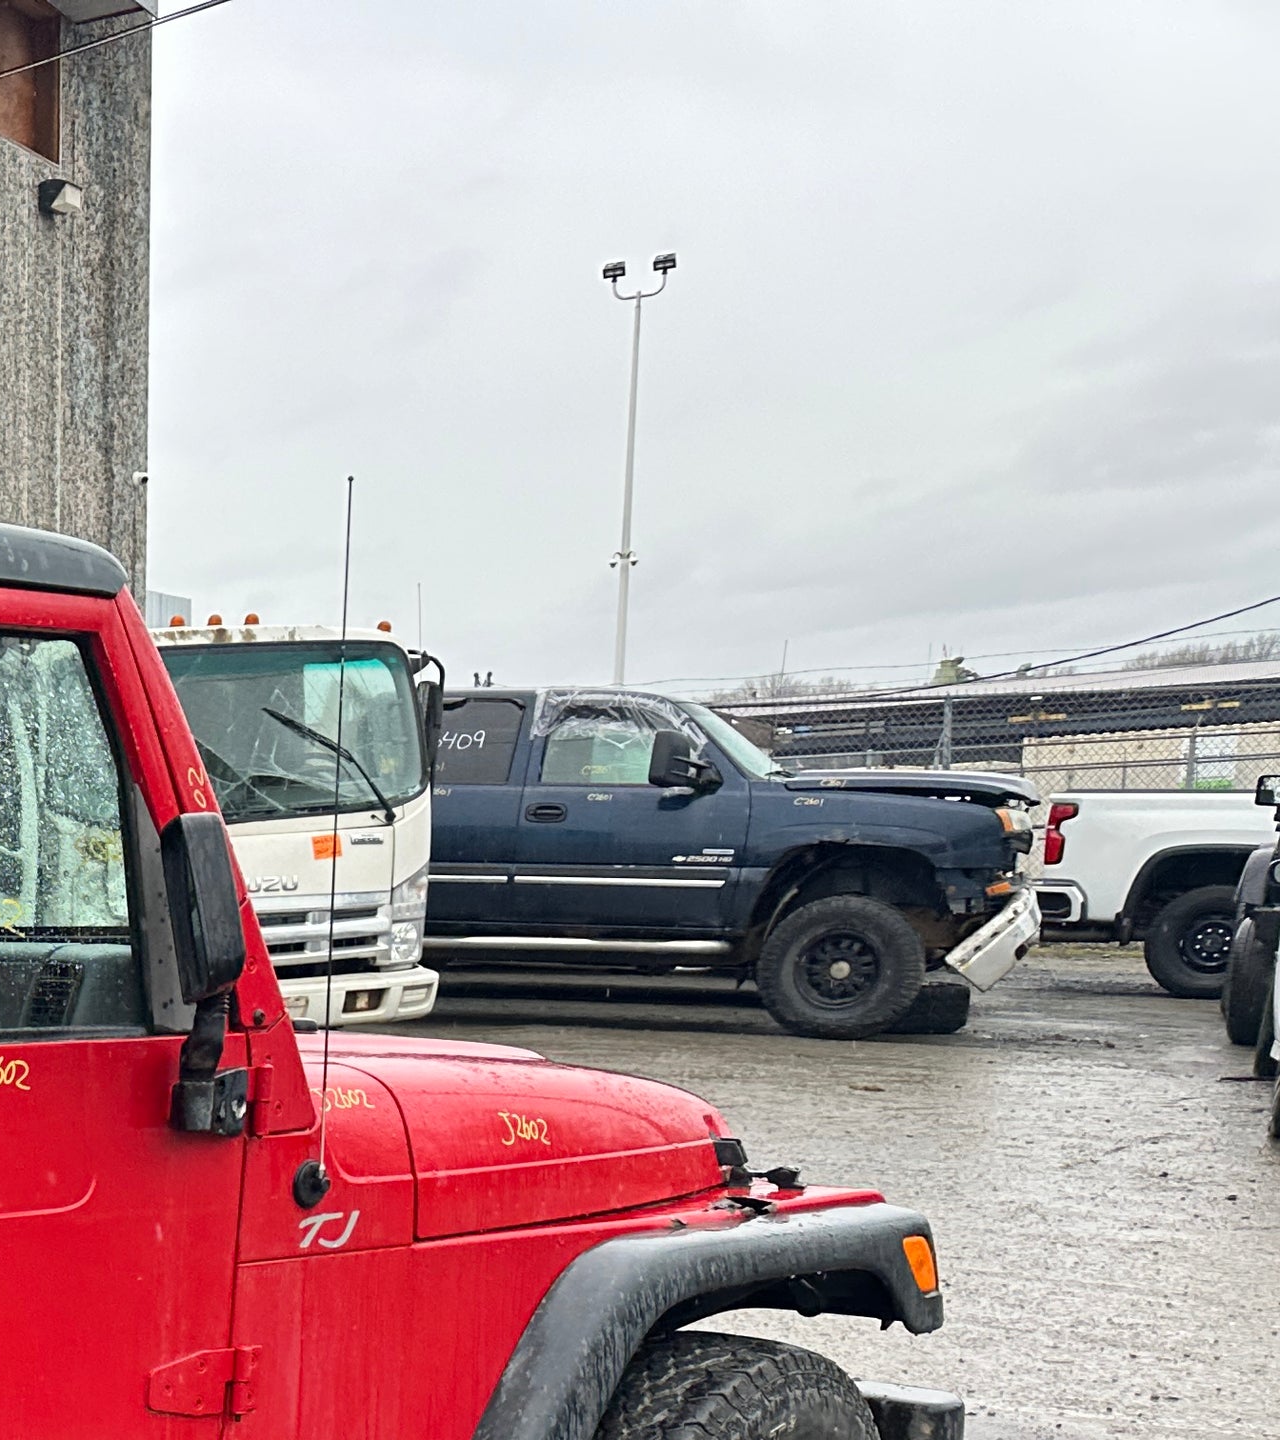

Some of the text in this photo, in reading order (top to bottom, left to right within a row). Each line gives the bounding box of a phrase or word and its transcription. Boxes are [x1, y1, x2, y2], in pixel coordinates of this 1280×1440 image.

[247, 874, 299, 893] UZU
[310, 1086, 376, 1112] J2602
[498, 1110, 552, 1146] J2602
[298, 1210, 360, 1249] TJ
